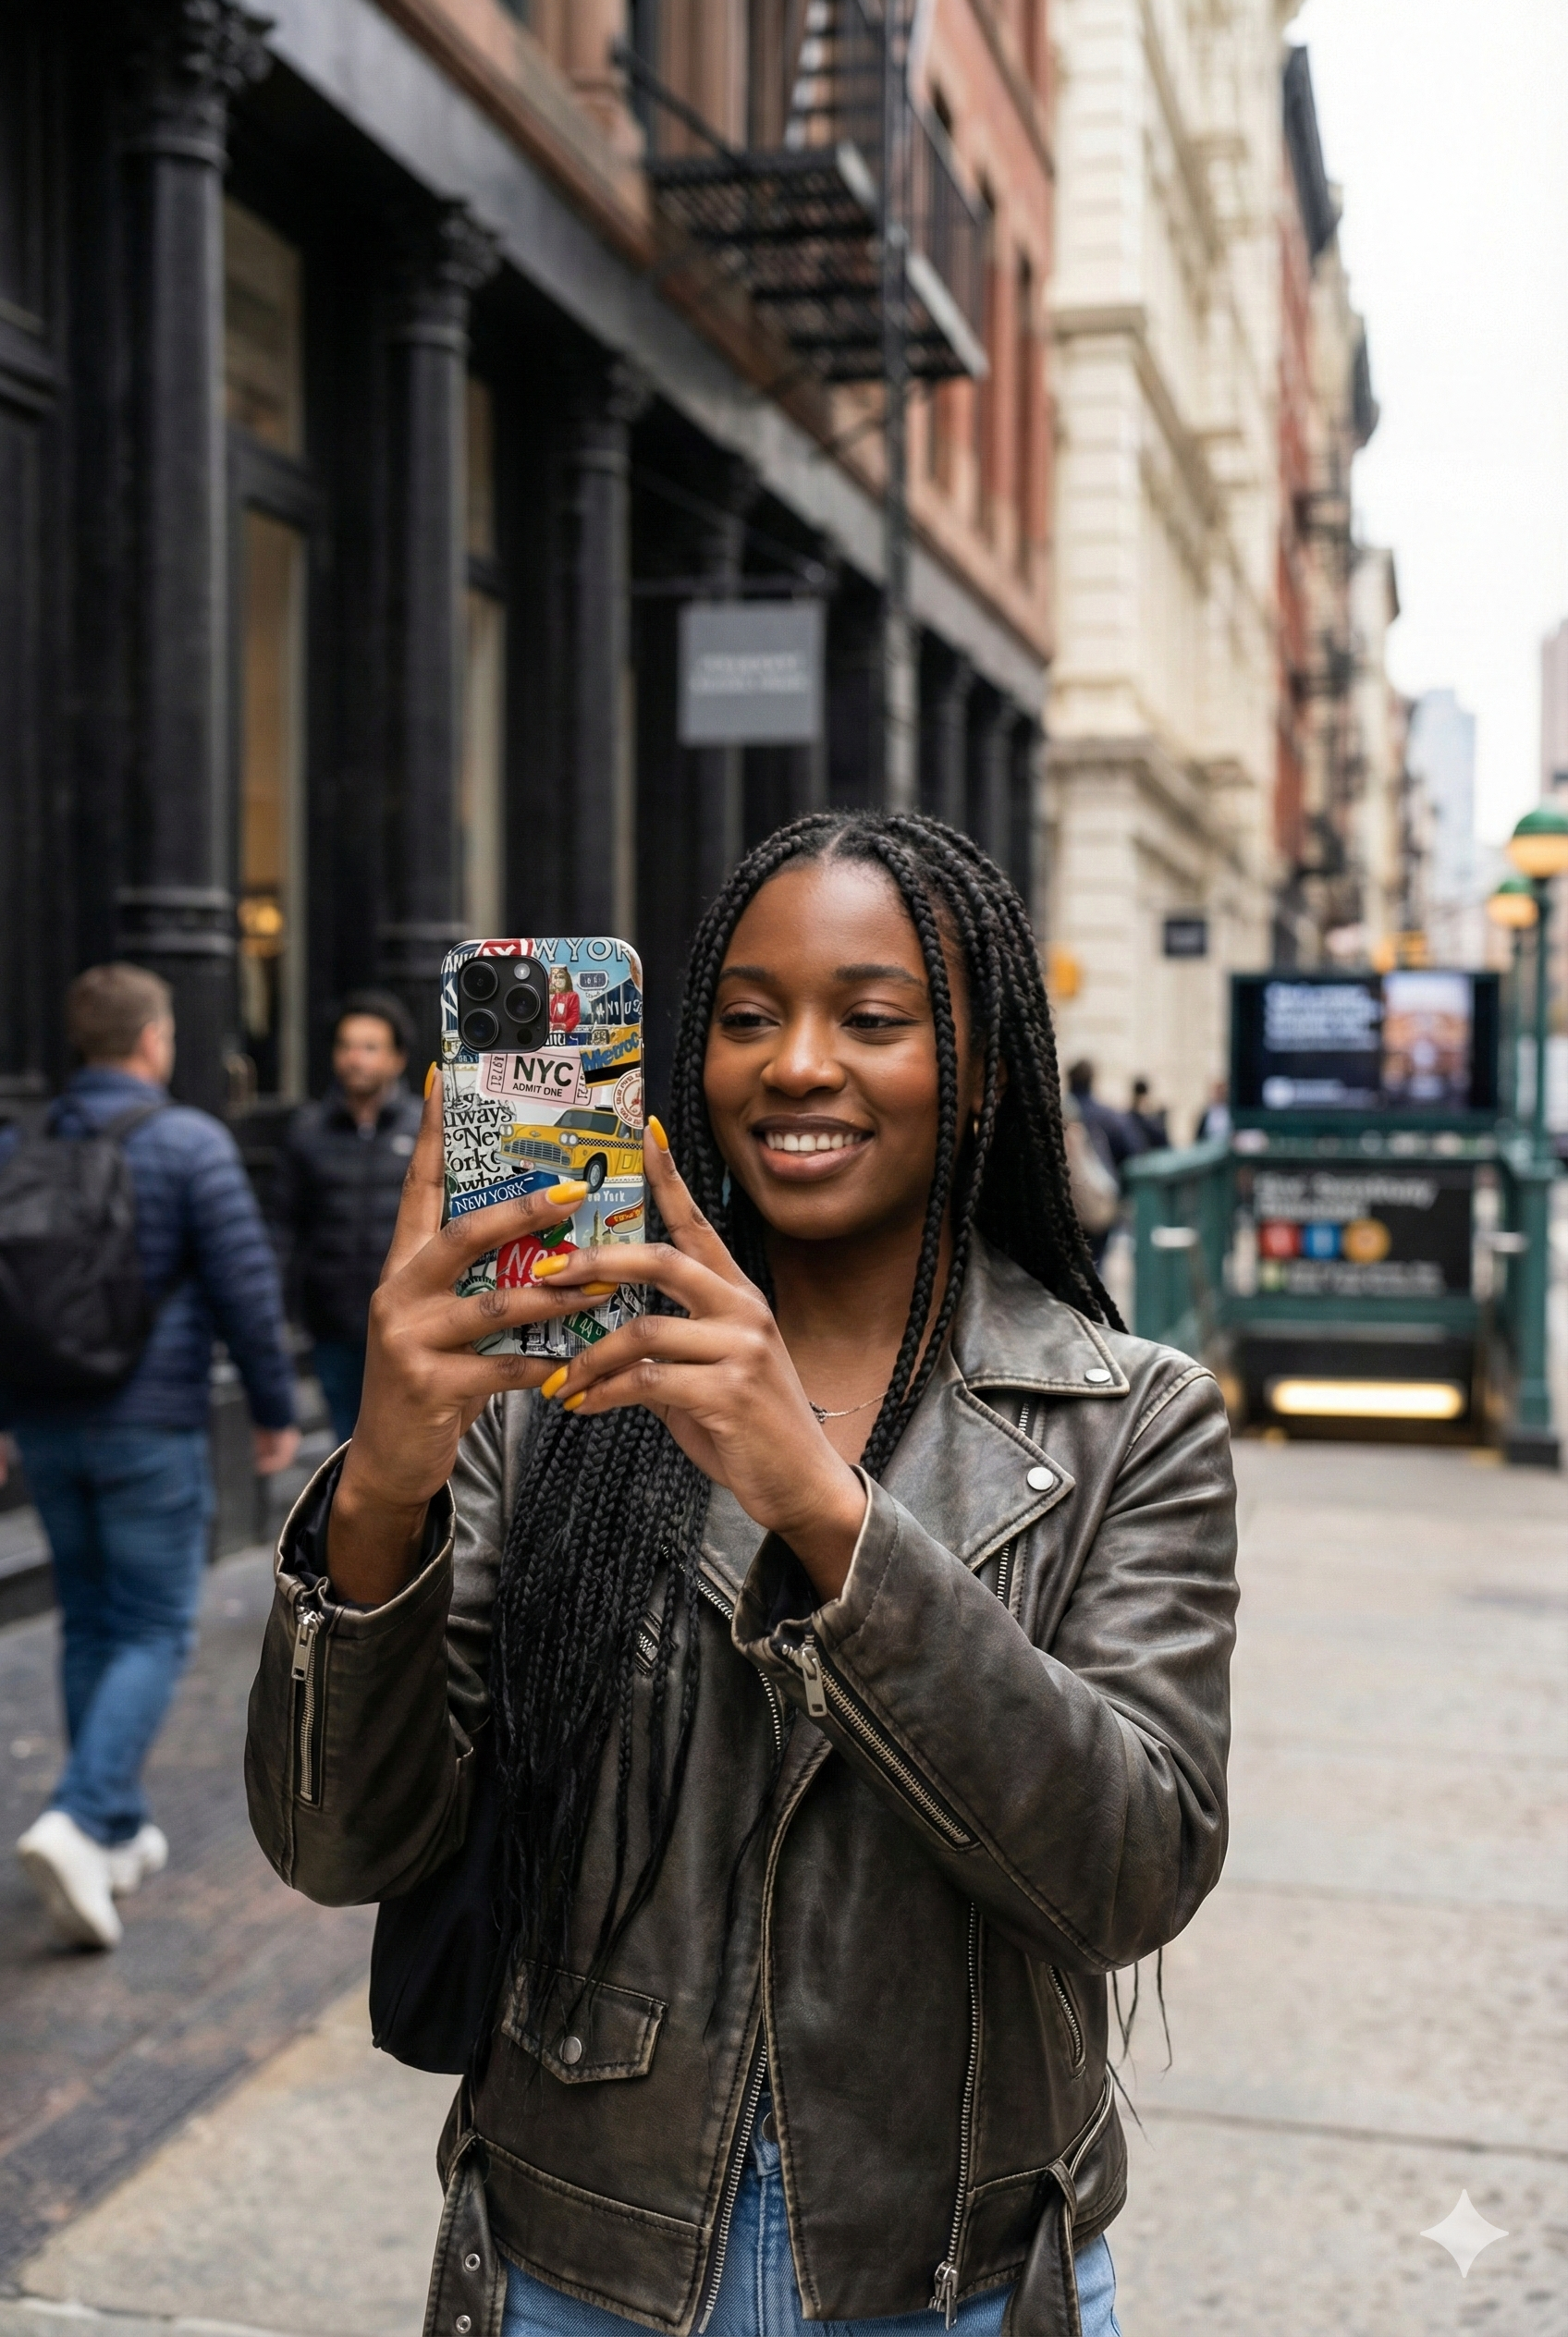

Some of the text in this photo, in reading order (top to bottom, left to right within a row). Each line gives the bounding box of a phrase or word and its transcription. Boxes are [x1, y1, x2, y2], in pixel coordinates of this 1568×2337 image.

[513, 1056, 573, 1086] NYC
[512, 1083, 542, 1094] ADMIT
[455, 1181, 528, 1213] NEW YORK
